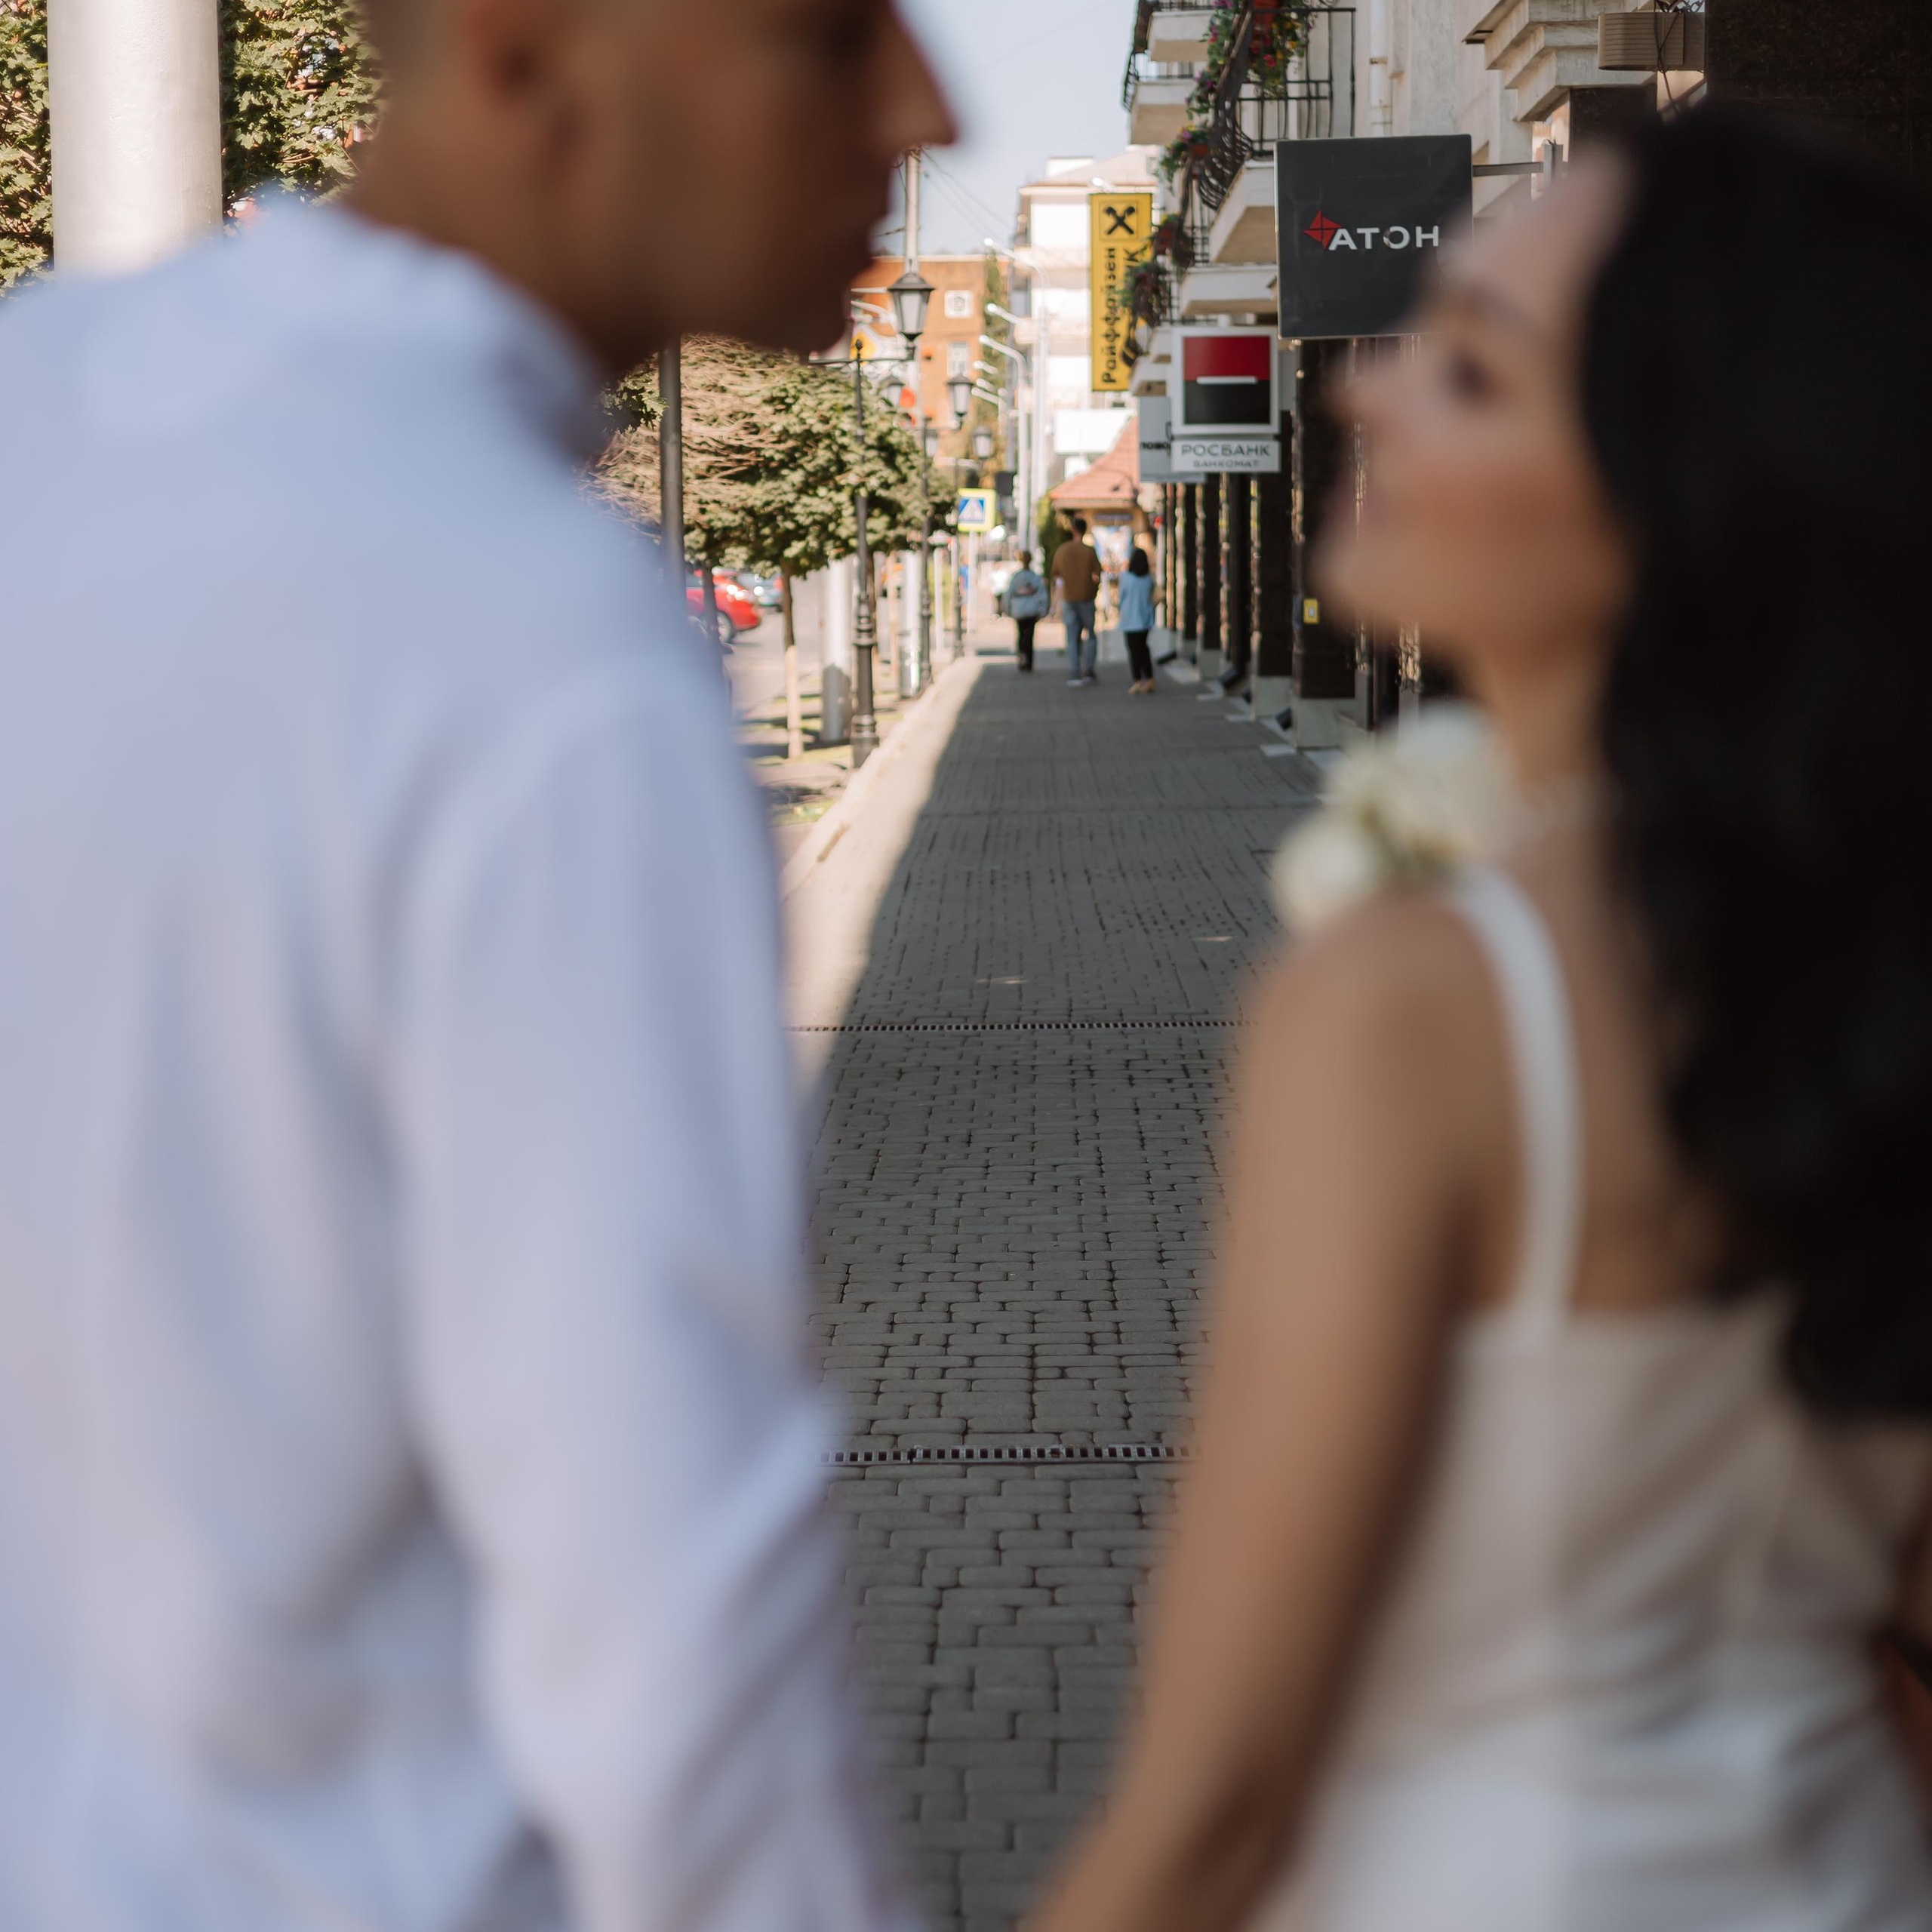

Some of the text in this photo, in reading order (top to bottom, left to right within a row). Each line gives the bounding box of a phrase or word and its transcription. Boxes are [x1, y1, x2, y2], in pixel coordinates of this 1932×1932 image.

[1328, 225, 1439, 251] АТОН
[1181, 444, 1270, 457] РОСБАНК
[1192, 460, 1259, 468] БАНКОМАТ
